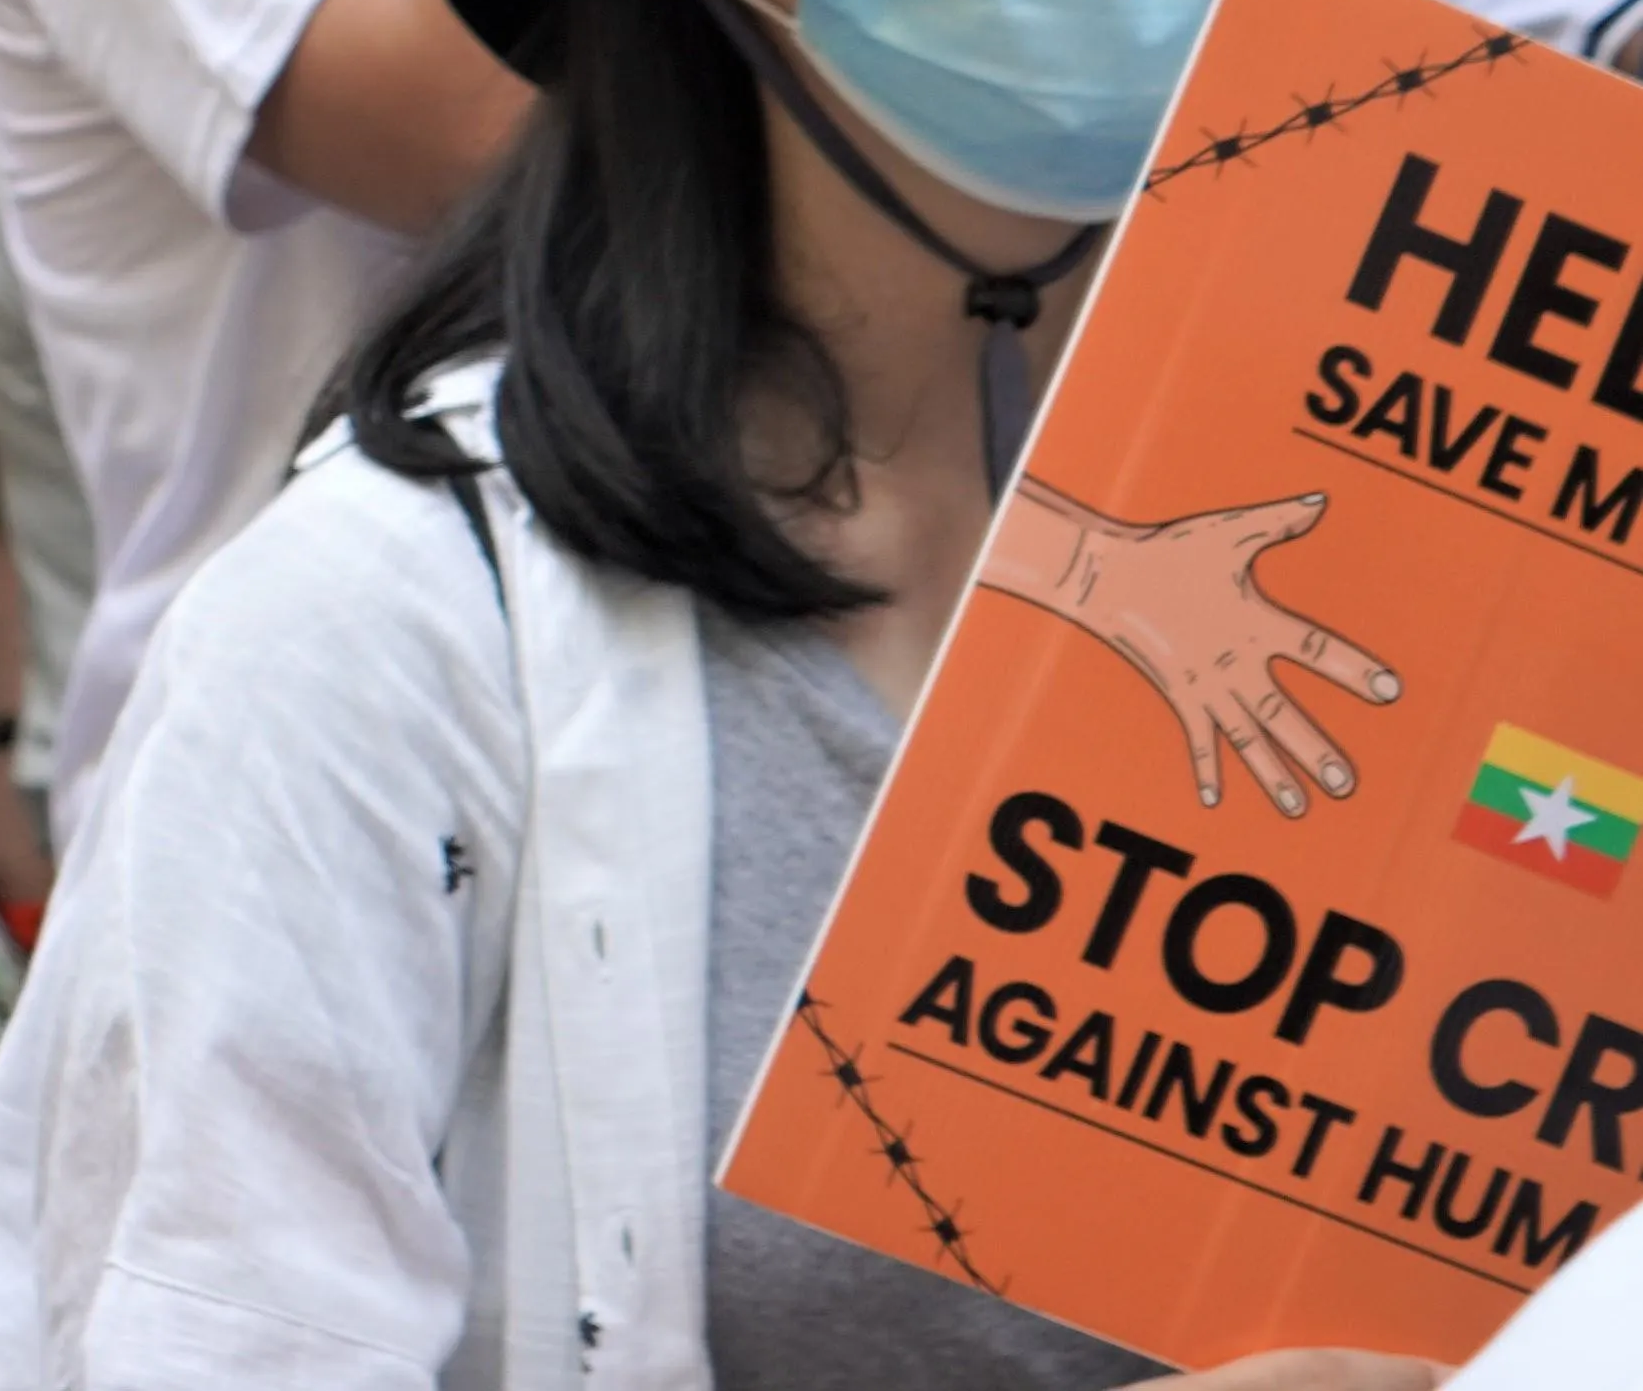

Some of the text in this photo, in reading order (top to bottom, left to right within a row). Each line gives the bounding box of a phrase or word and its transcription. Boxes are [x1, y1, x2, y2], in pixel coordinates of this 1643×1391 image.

[1304, 344, 1551, 502] SAVE
[899, 956, 1358, 1179] AGAINST
[964, 790, 1643, 1182] STOP CR
